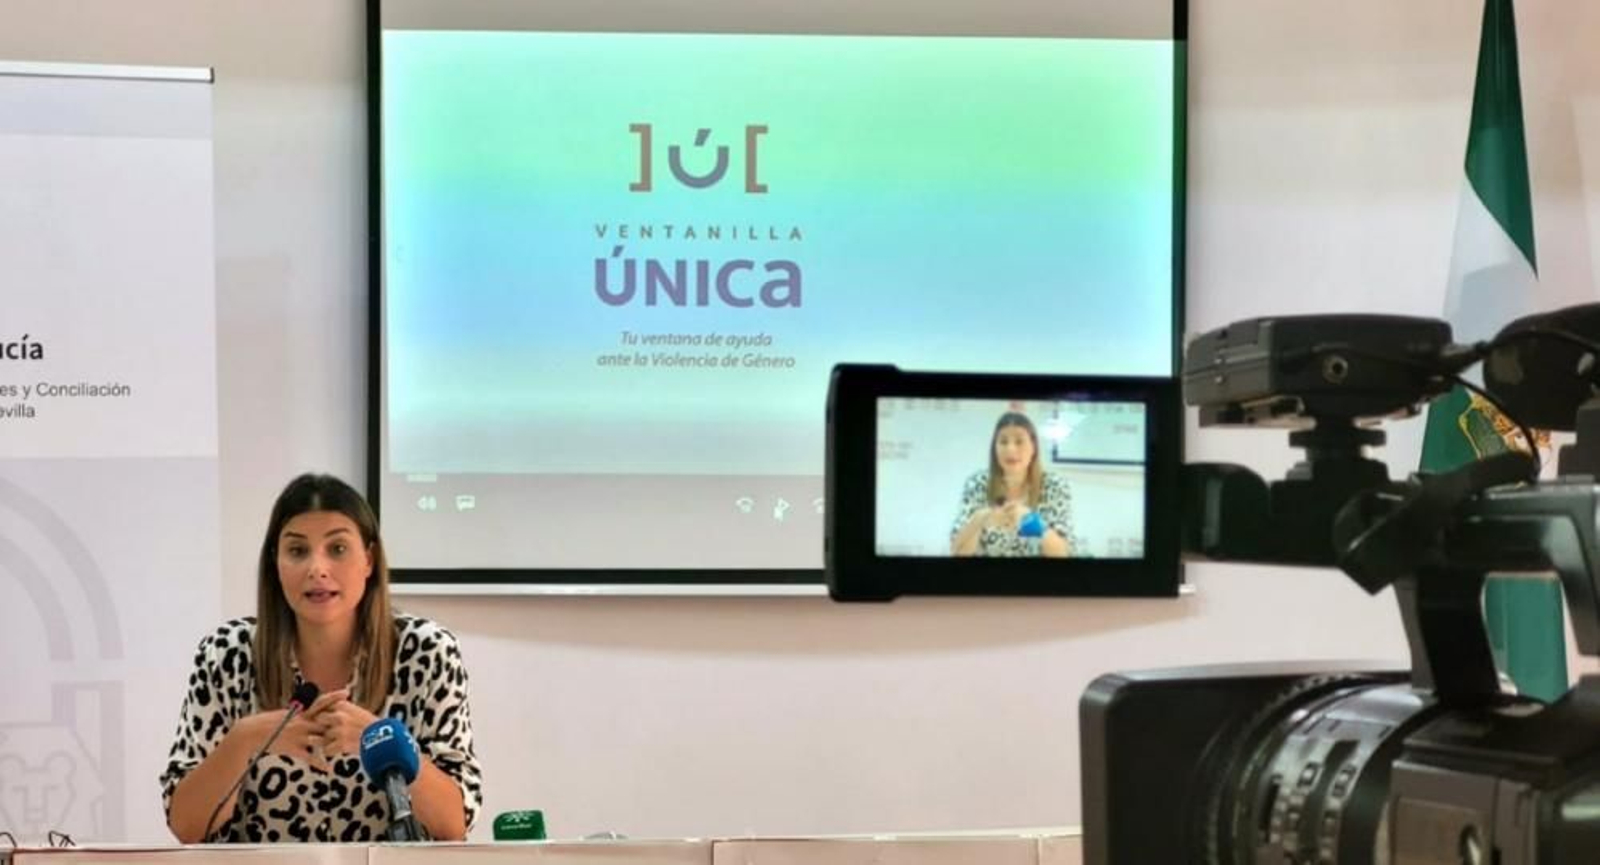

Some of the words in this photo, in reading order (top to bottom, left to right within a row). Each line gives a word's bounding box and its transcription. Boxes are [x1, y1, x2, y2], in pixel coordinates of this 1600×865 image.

[594, 225, 803, 240] VENTANILLA
[0, 334, 44, 360] cía
[621, 331, 638, 345] Tu
[641, 333, 702, 346] ventana
[705, 332, 722, 346] de
[726, 332, 772, 349] ayuda
[597, 354, 632, 366] ante
[635, 352, 648, 366] la
[651, 353, 718, 367] Violencia
[721, 353, 739, 367] de
[743, 353, 795, 368] Género
[23, 385, 31, 399] y
[36, 383, 130, 397] Conciliación
